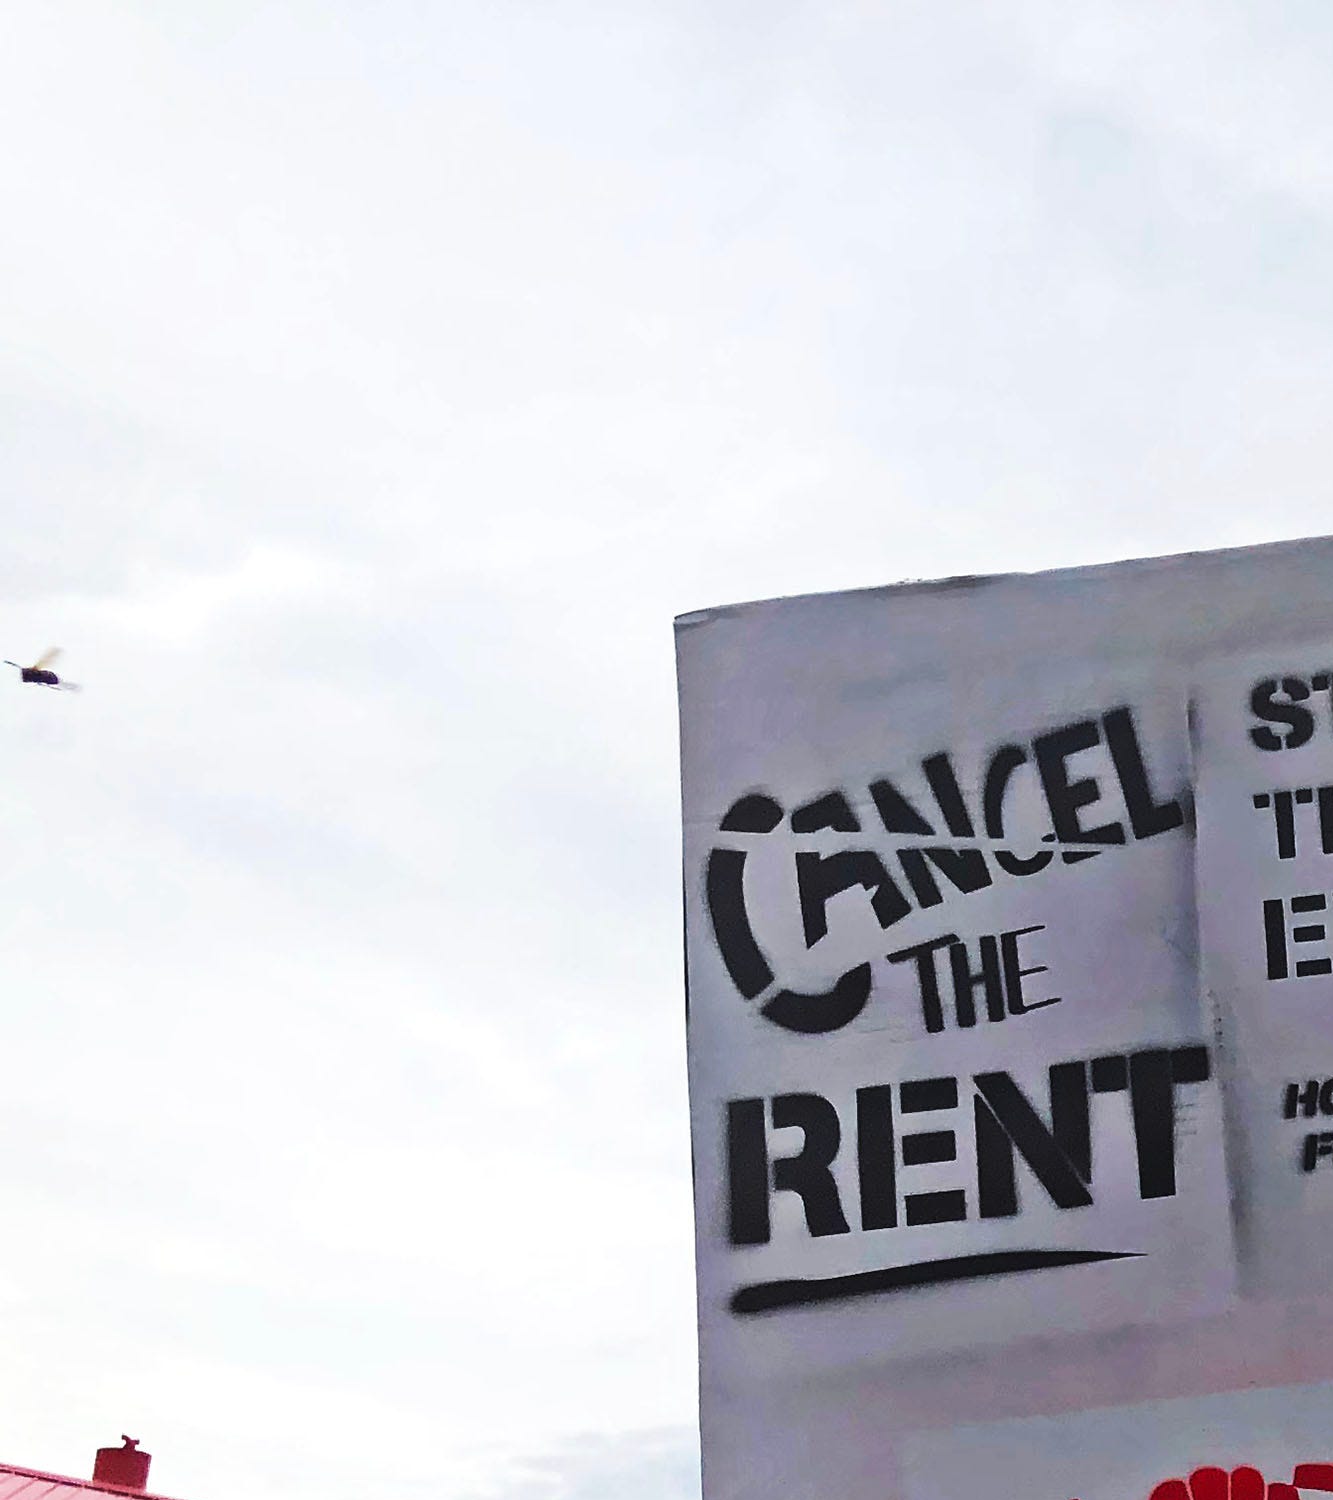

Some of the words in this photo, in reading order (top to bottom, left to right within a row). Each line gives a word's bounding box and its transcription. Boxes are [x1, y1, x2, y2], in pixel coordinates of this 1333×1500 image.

[706, 706, 1184, 1033] CANCEL
[886, 925, 1062, 1034] THE
[726, 1046, 1210, 1245] RENT
